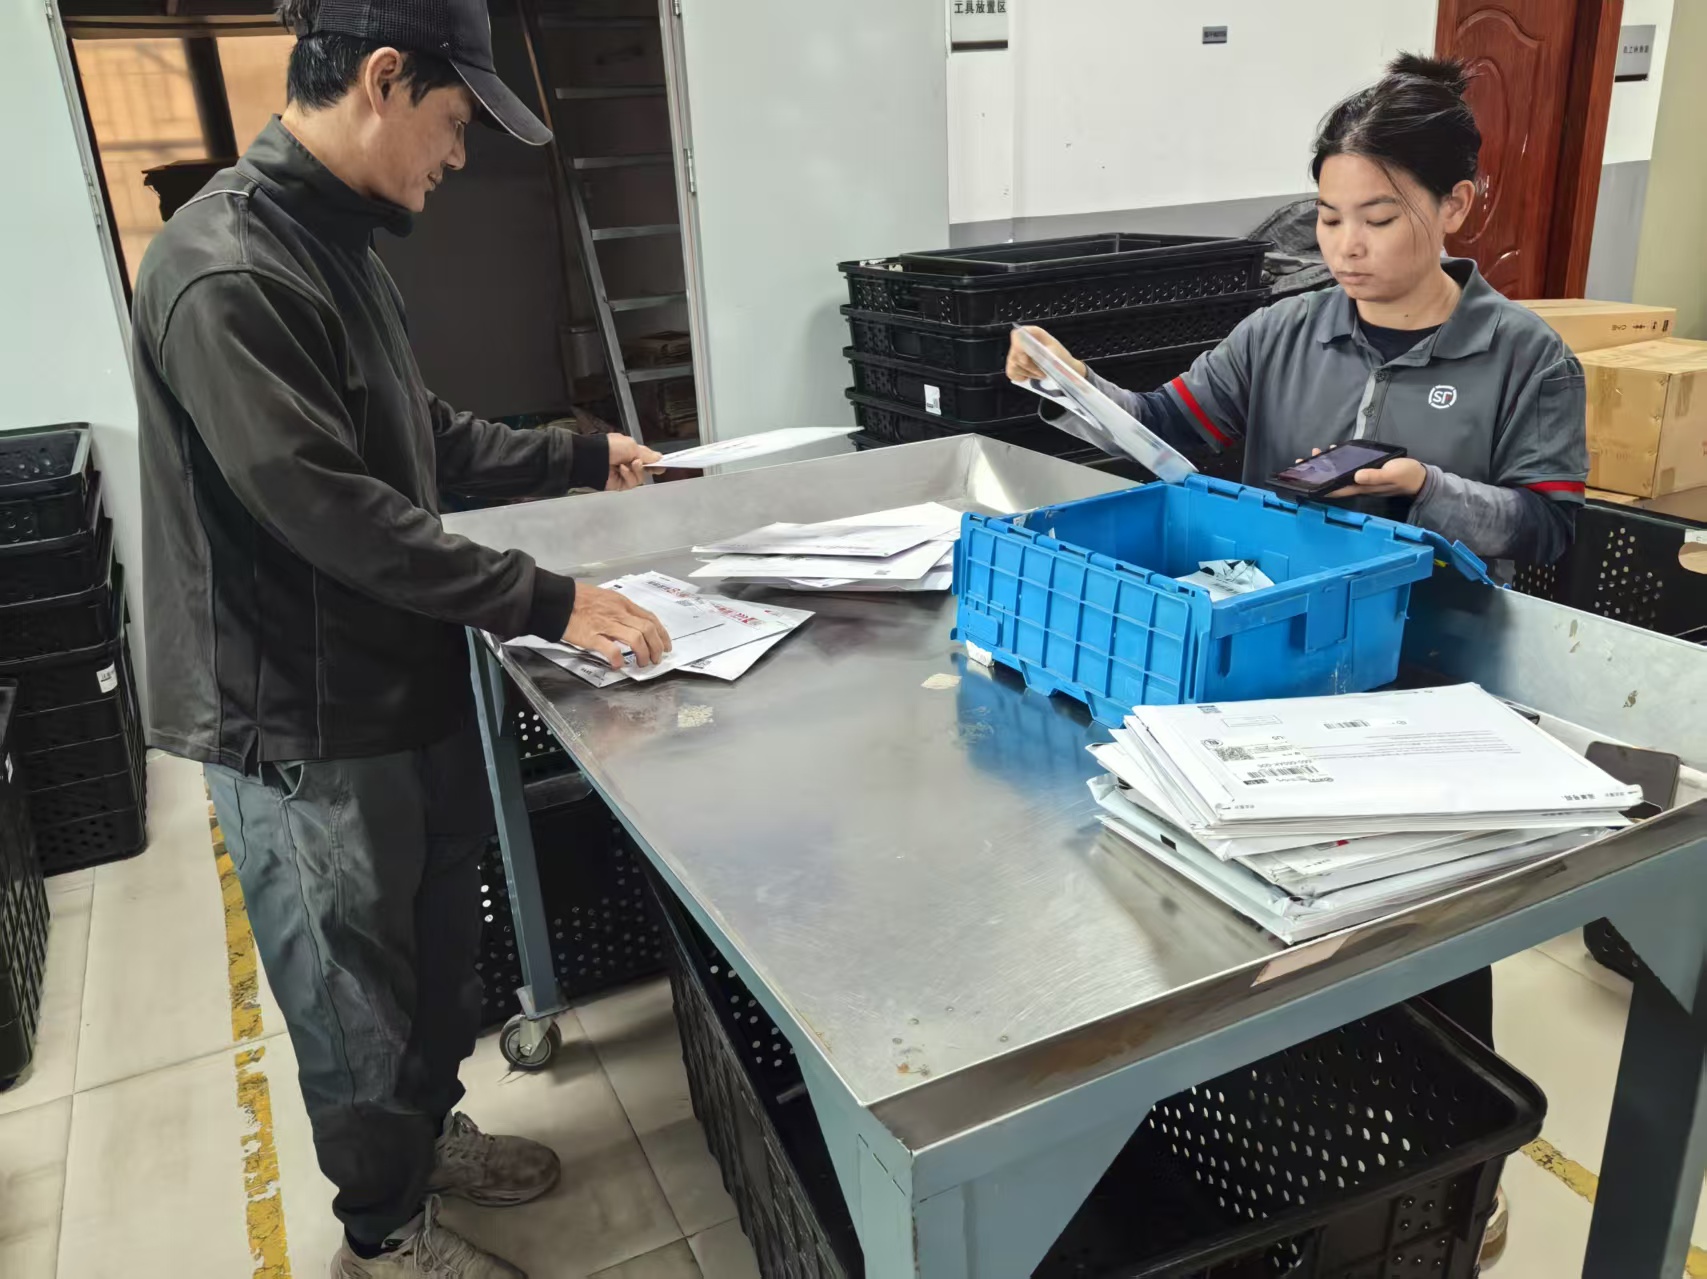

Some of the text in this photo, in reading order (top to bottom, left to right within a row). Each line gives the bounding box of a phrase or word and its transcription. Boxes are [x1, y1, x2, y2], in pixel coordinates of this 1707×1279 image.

[954, 0, 1006, 14] 工具放置区
[1432, 390, 1453, 404] SF
